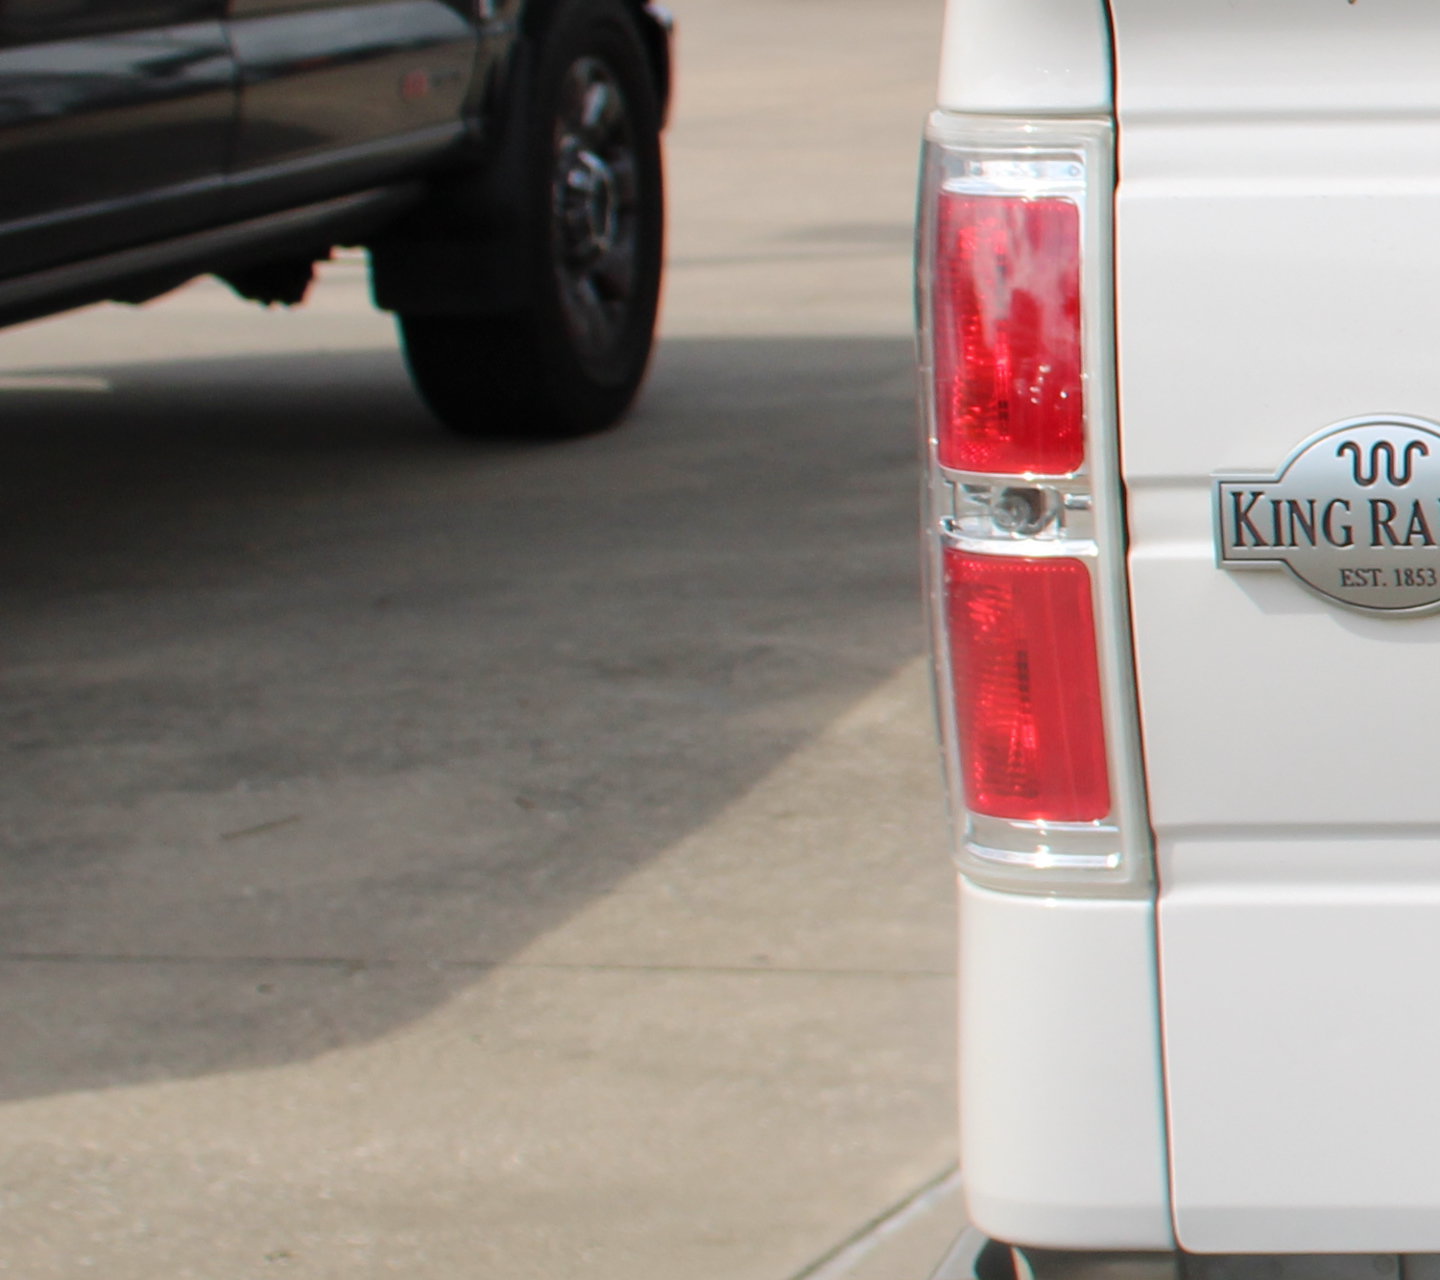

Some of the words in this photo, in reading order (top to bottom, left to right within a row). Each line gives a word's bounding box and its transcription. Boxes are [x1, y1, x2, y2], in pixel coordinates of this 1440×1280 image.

[1231, 490, 1354, 548] KING
[1339, 568, 1387, 588] EST.
[1393, 568, 1438, 588] 1853
